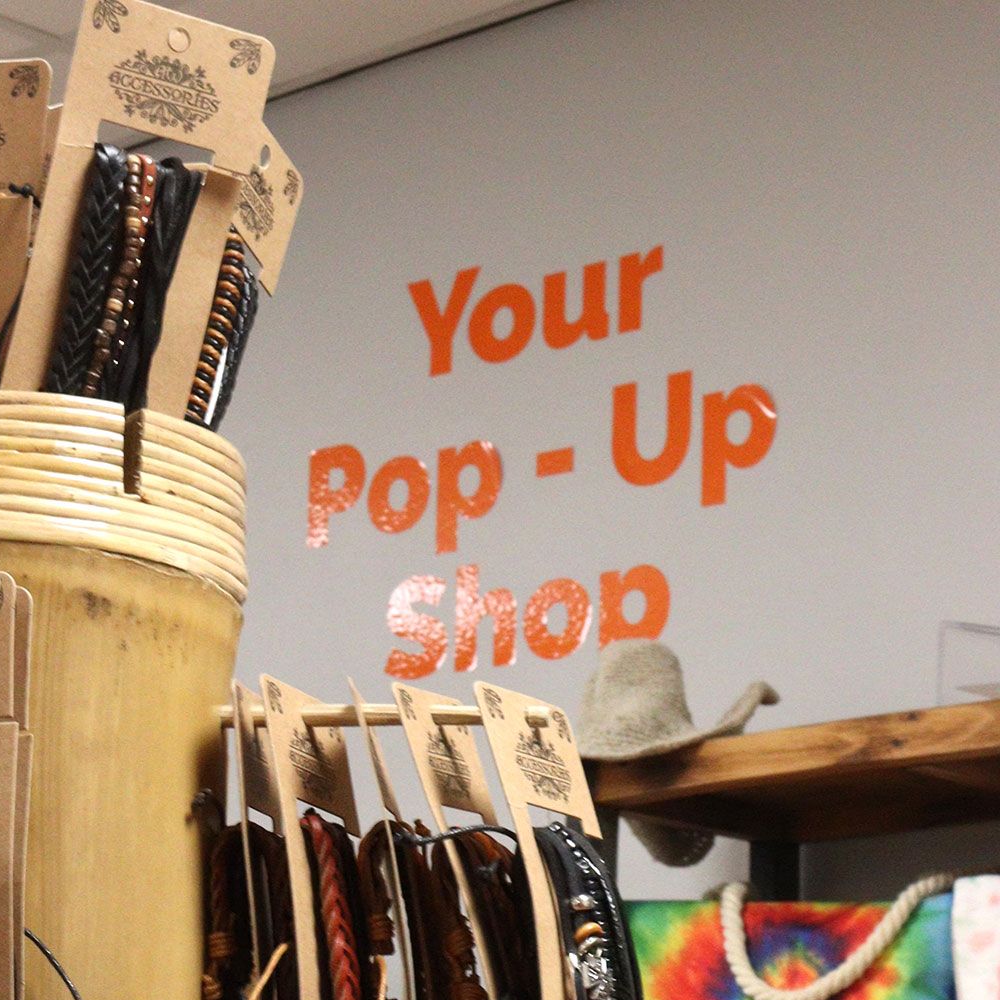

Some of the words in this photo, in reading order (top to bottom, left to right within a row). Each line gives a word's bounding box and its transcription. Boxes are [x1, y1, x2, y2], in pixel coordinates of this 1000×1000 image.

[108, 71, 219, 113] ACCESSORIES
[408, 245, 664, 377] Your
[306, 440, 502, 554] Pop
[611, 370, 777, 507] Up
[384, 563, 670, 680] Shop
